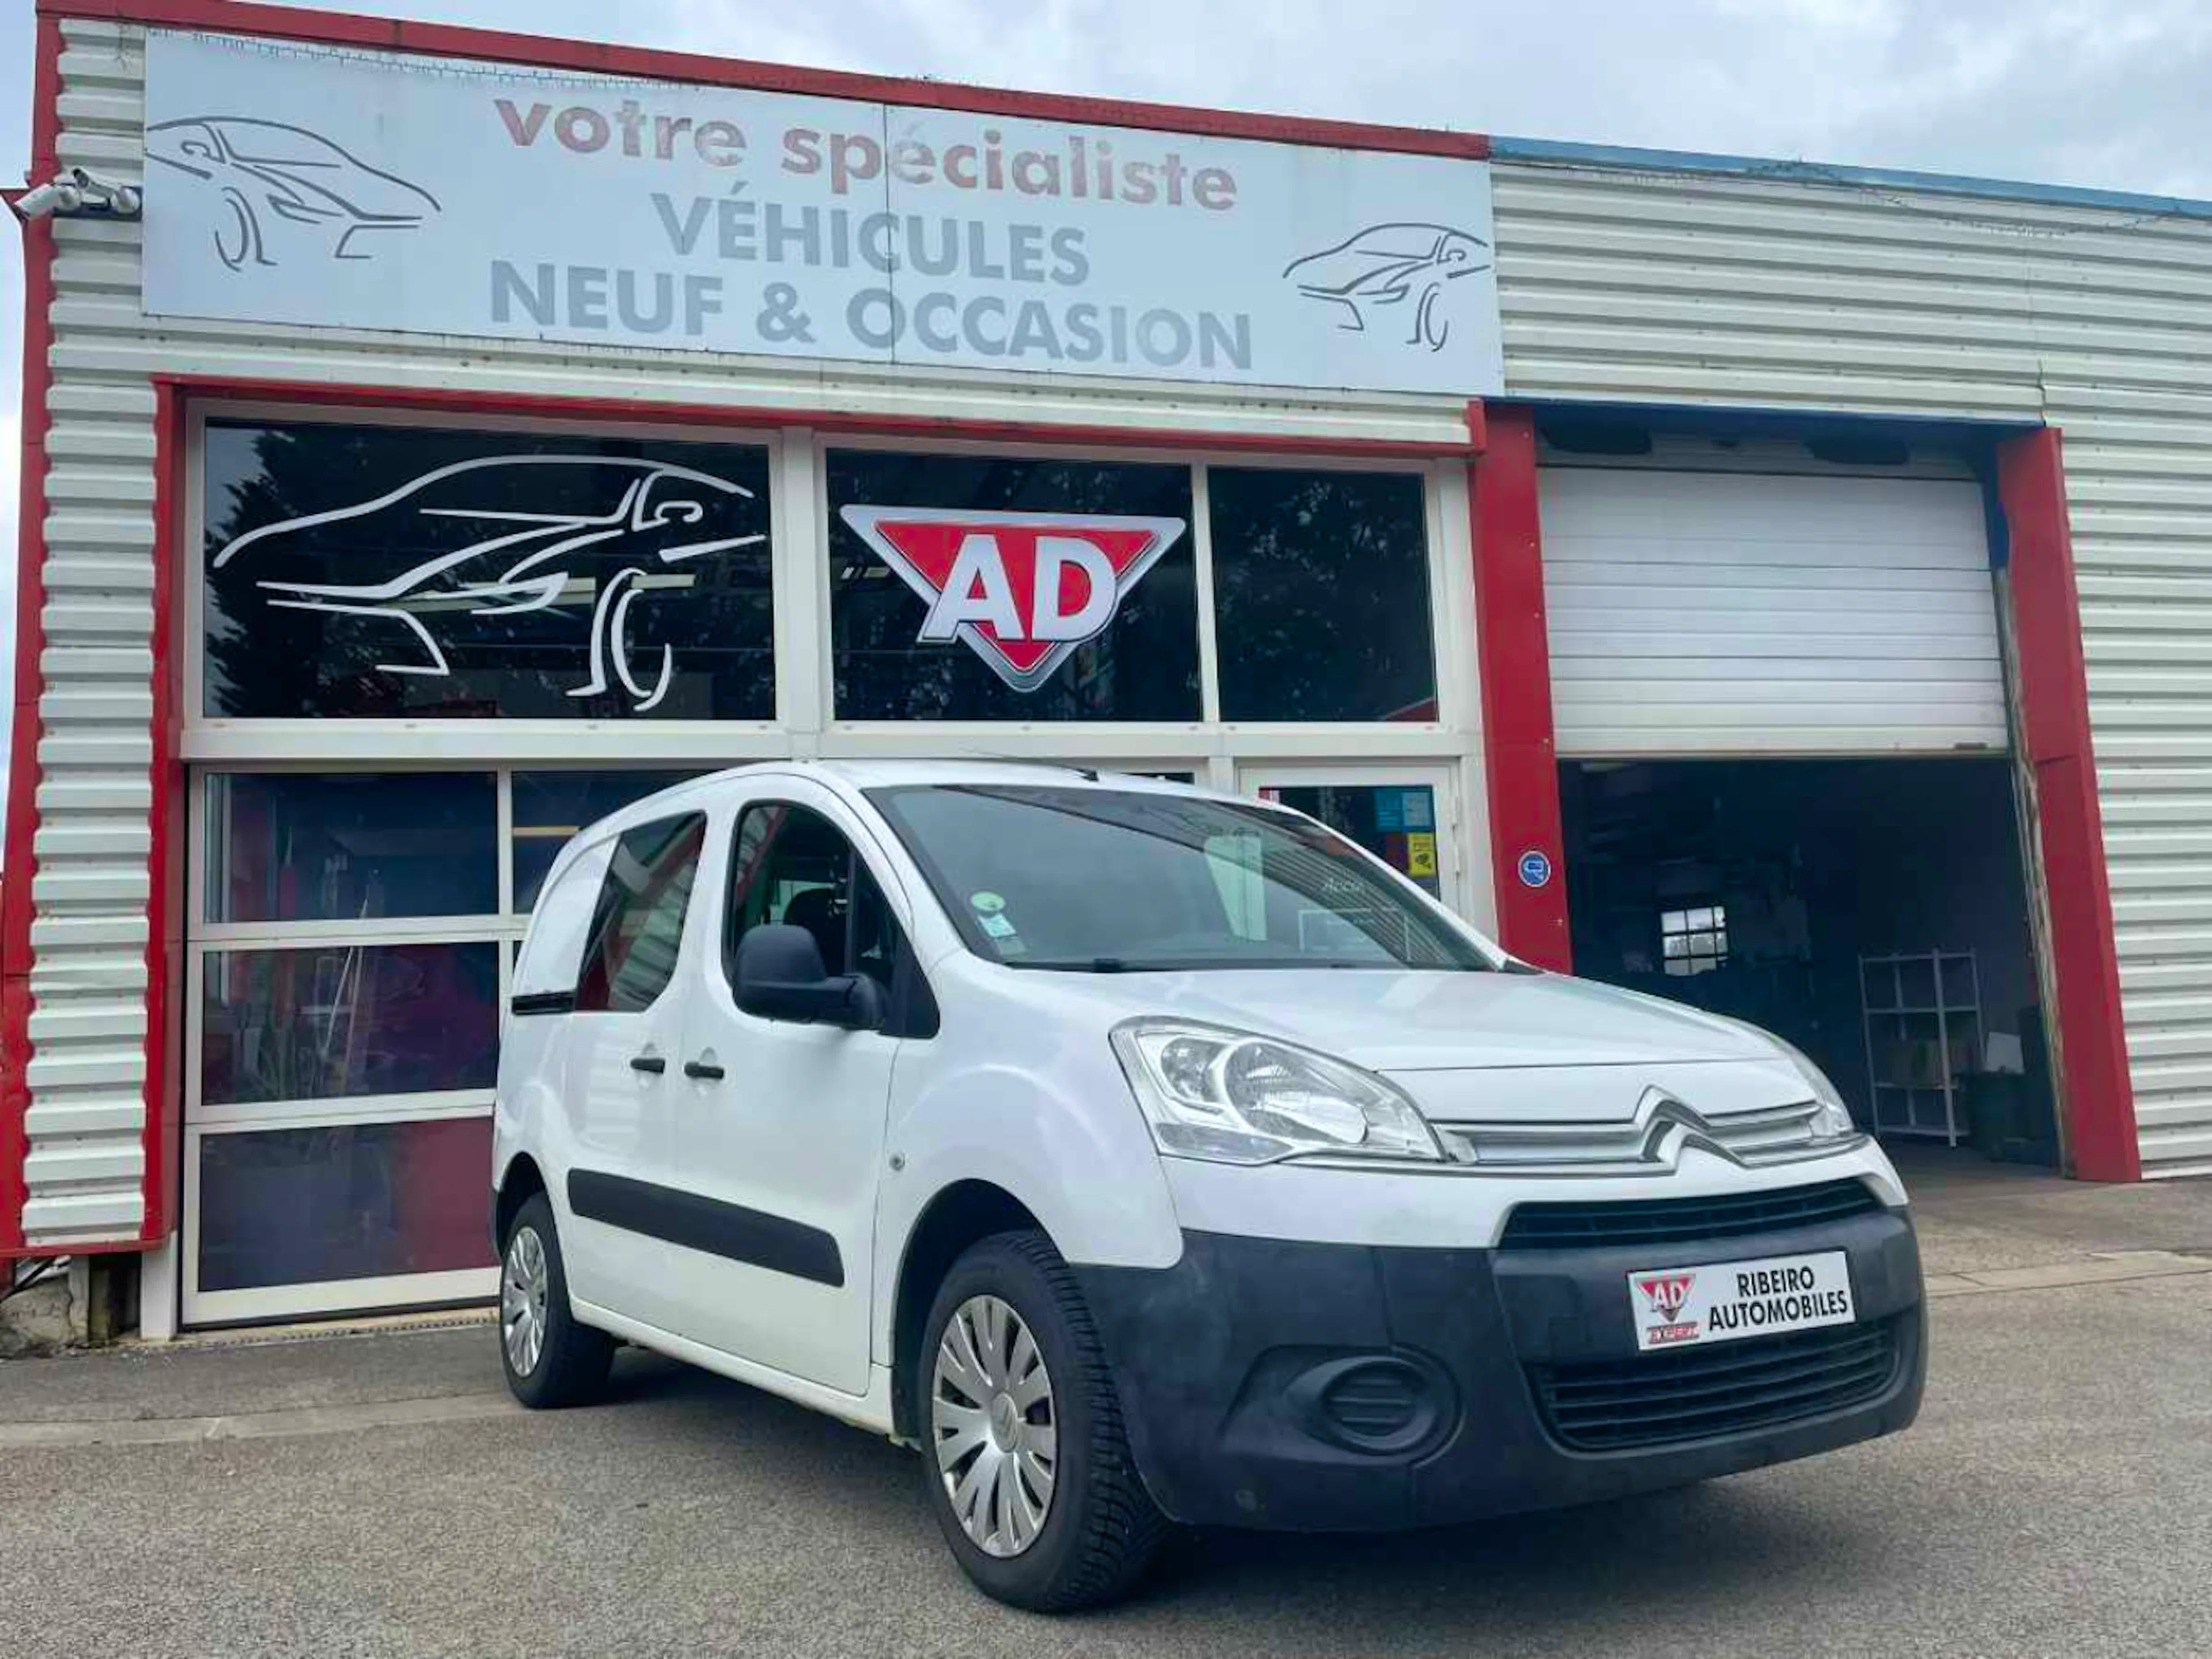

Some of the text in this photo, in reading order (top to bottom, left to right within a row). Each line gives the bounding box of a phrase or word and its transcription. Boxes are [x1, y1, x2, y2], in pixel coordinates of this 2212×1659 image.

[494, 99, 1237, 211] votre spécialiste
[650, 180, 1090, 287] VÉHICULES
[491, 259, 1252, 370] NEUF & OCCASION
[916, 532, 1118, 645] AD
[1650, 1281, 1685, 1312] AD
[1709, 1289, 1848, 1332] AUTOMOBILES
[1736, 1266, 1815, 1298] RIBEIRO
